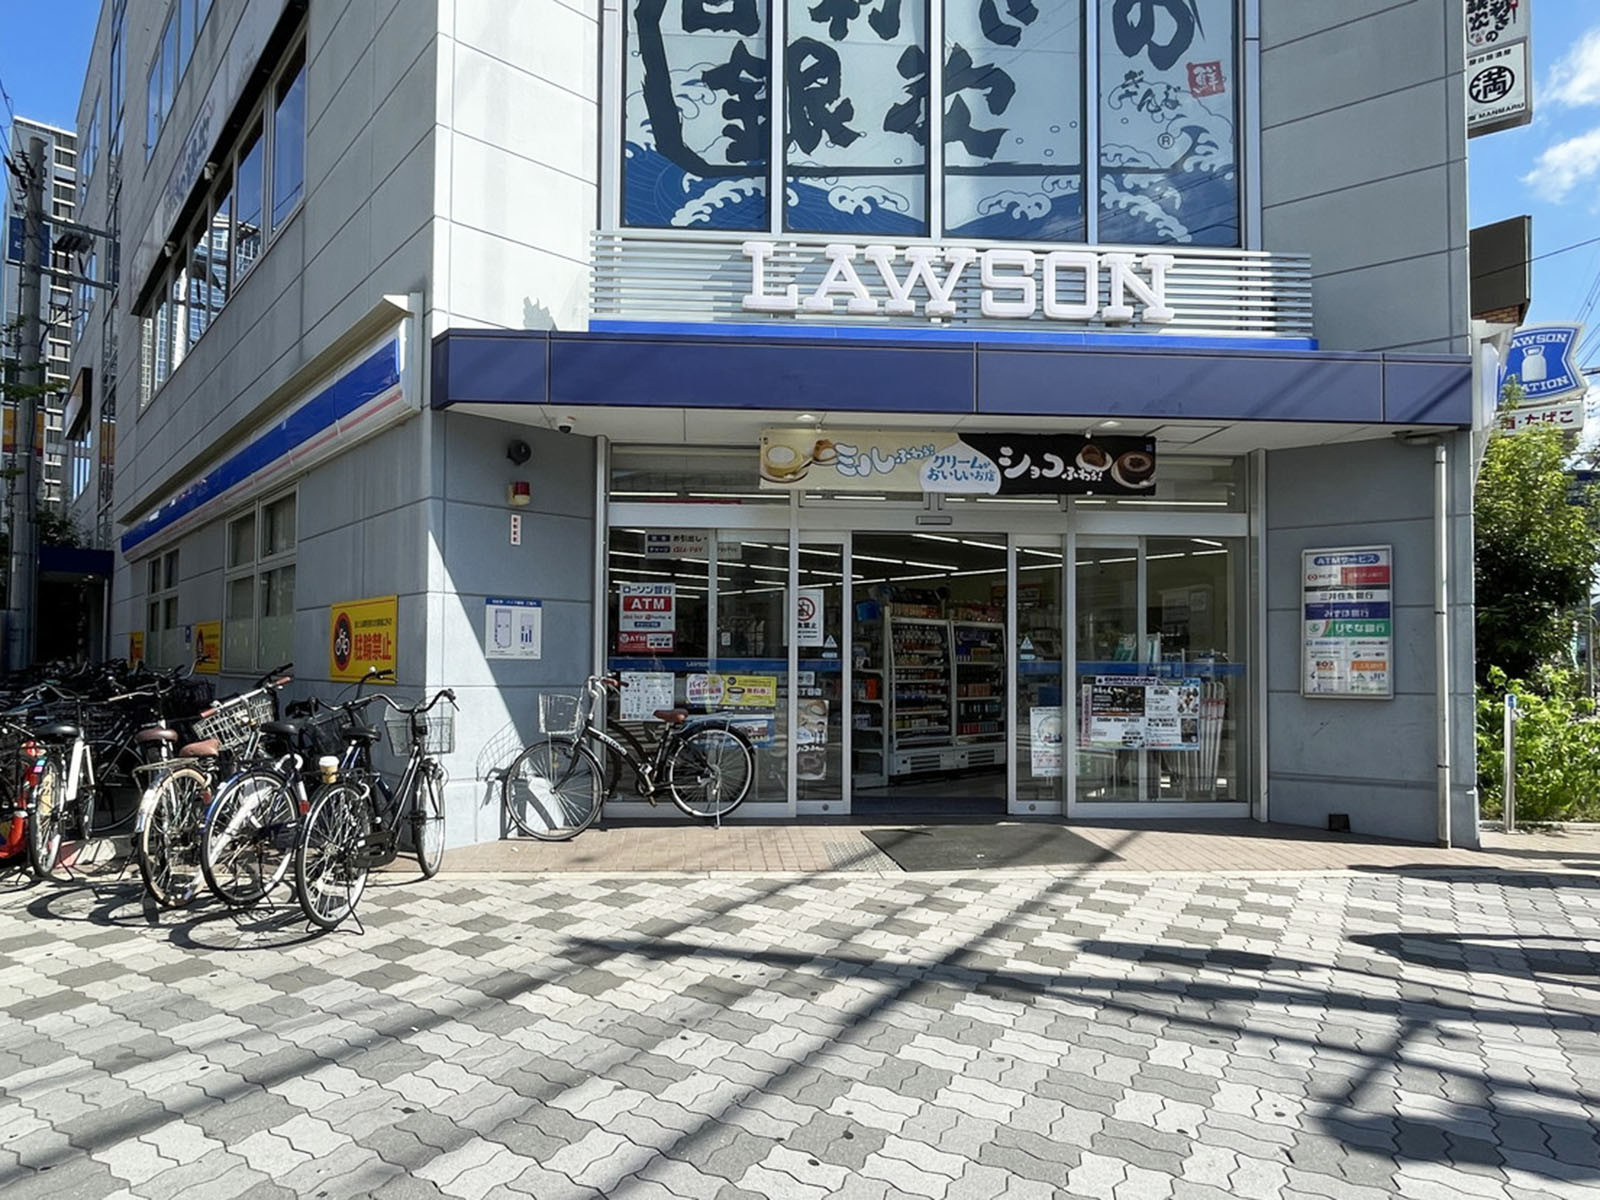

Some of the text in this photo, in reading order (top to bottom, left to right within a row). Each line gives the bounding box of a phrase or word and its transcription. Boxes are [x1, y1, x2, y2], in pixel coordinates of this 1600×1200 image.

[741, 241, 1175, 322] LAWSON
[1510, 333, 1569, 349] AWSON
[1520, 375, 1570, 393] ATION
[933, 455, 991, 469] クリームが
[927, 467, 996, 482] おいしいお店
[631, 598, 665, 610] ATM
[353, 631, 393, 662] 駐輪禁止
